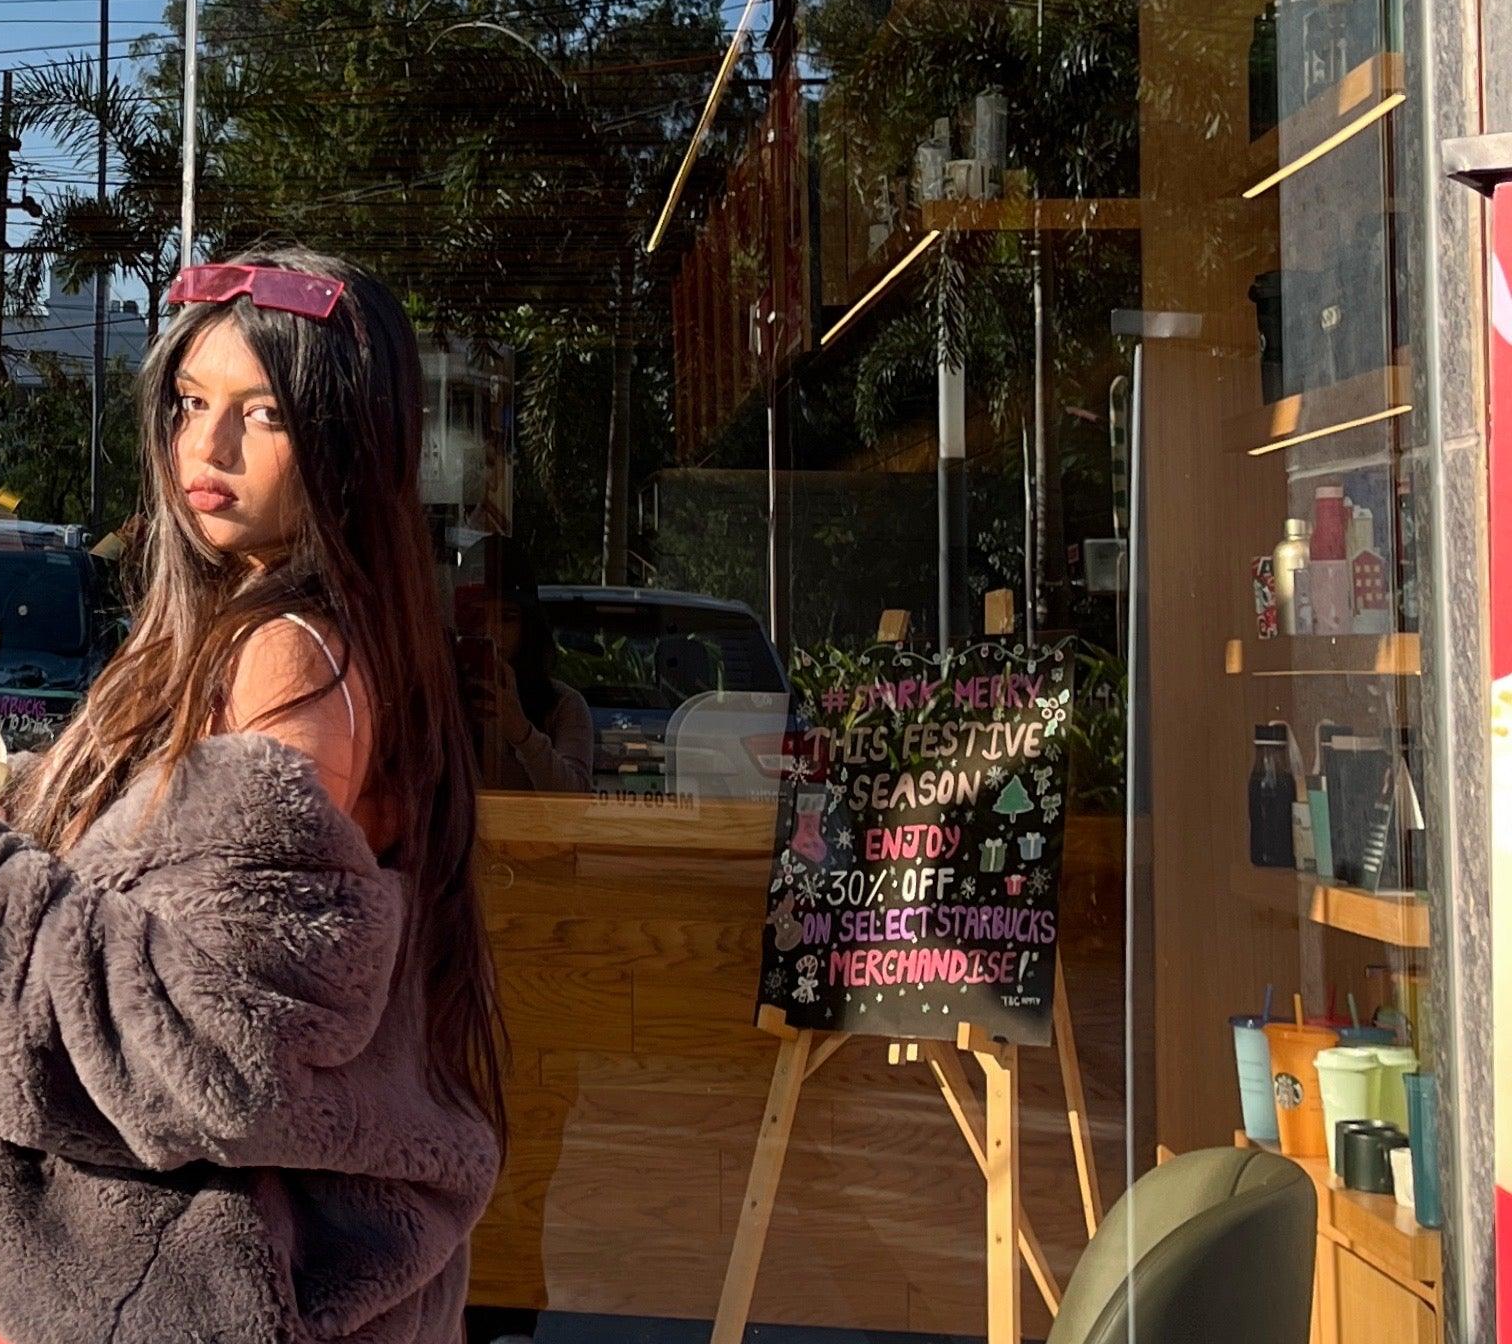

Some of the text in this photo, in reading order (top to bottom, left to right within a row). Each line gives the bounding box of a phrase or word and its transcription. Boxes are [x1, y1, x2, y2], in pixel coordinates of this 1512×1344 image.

[955, 674, 1044, 709] MERRY
[803, 721, 1043, 763] THIS FESTIVE
[848, 769, 981, 811] SEASON
[865, 824, 961, 862] ENJOY
[826, 867, 956, 907] 30% OFF
[802, 906, 1056, 945] ON SELECT STARBUCKS
